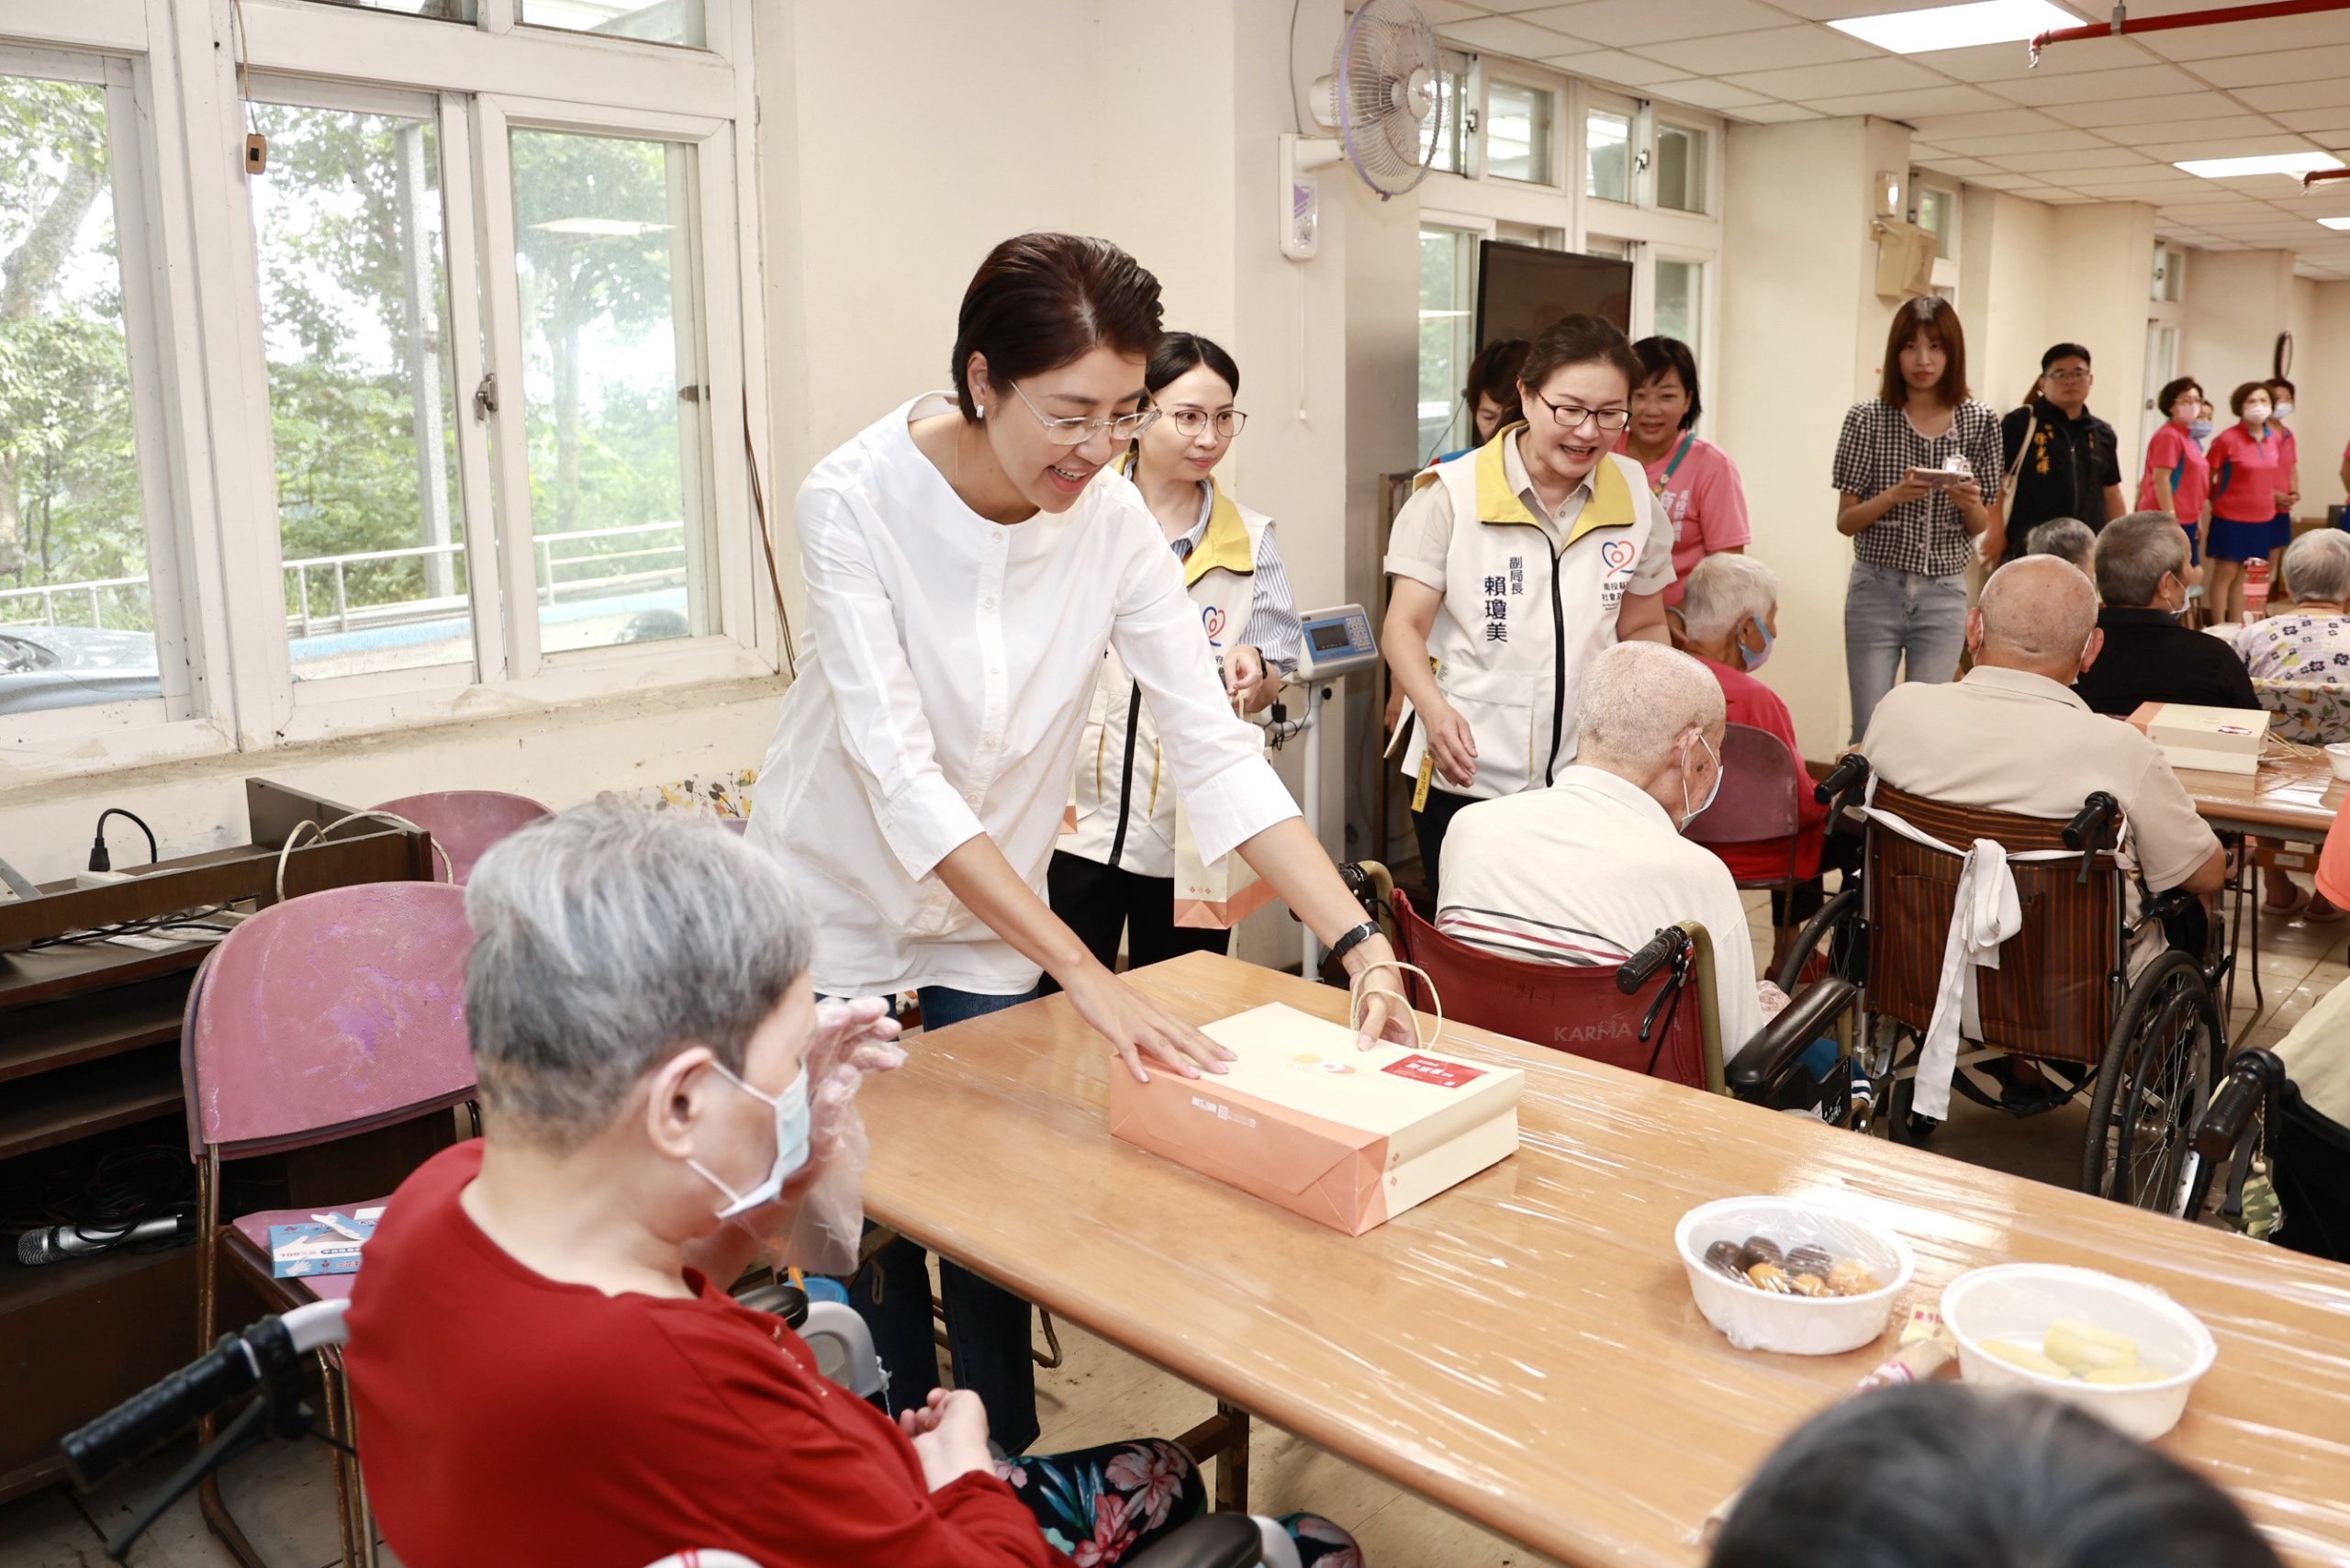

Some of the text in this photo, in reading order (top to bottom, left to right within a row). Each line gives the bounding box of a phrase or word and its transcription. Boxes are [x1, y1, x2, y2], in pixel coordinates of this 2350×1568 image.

[1509, 555, 1524, 595] 副局長
[1603, 581, 1629, 590] 南投縣
[1484, 575, 1508, 643] 賴瓊美
[1554, 1022, 1633, 1042] KARMA
